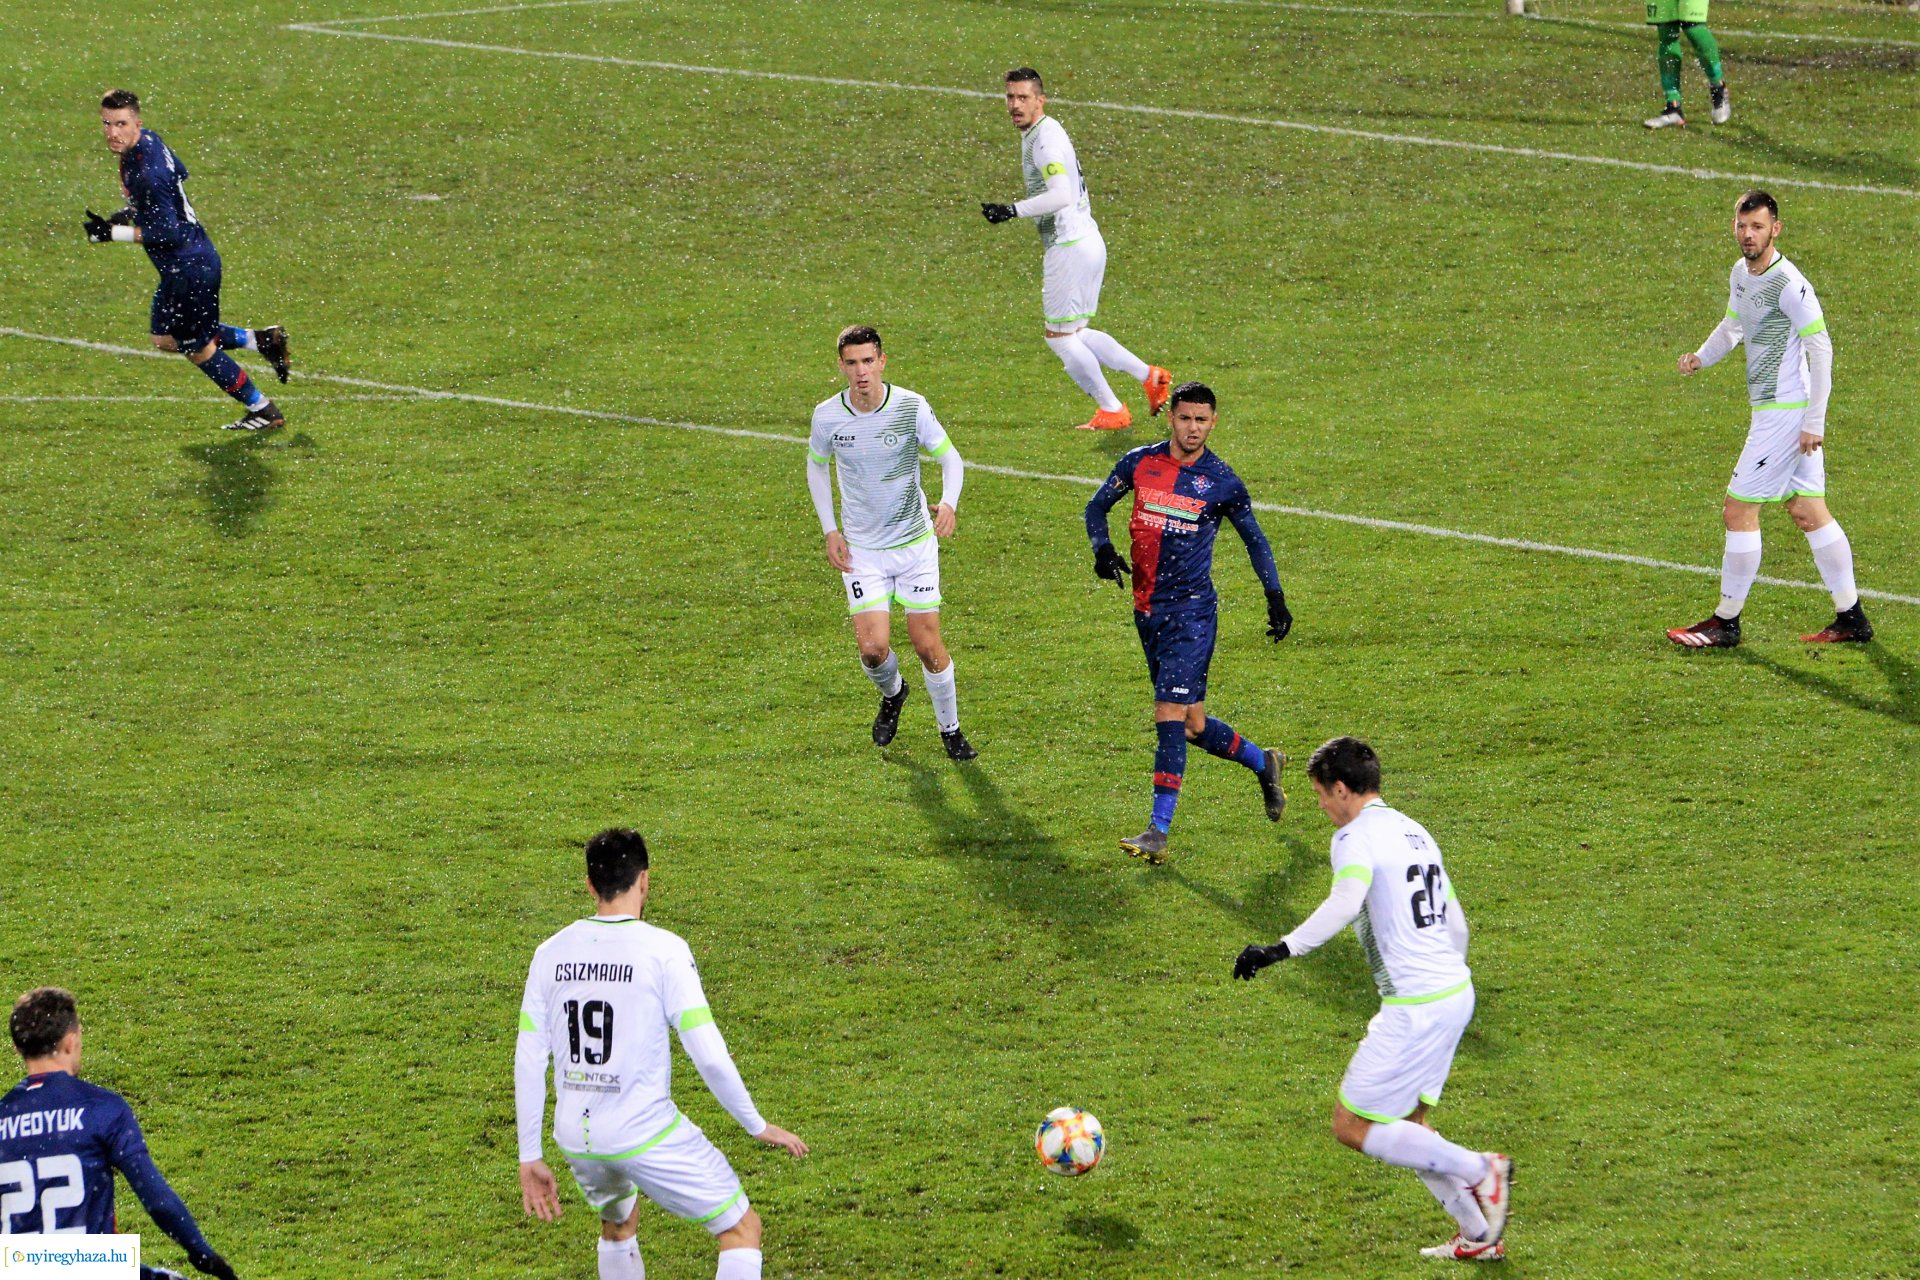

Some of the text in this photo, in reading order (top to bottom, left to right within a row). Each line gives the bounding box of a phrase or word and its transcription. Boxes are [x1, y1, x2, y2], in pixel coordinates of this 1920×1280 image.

[1046, 163, 1058, 176] C
[852, 580, 864, 599] 6
[1406, 864, 1447, 929] 20
[555, 962, 634, 983] CSIZMADIA
[563, 999, 614, 1065] 19
[0, 1153, 87, 1234] 22
